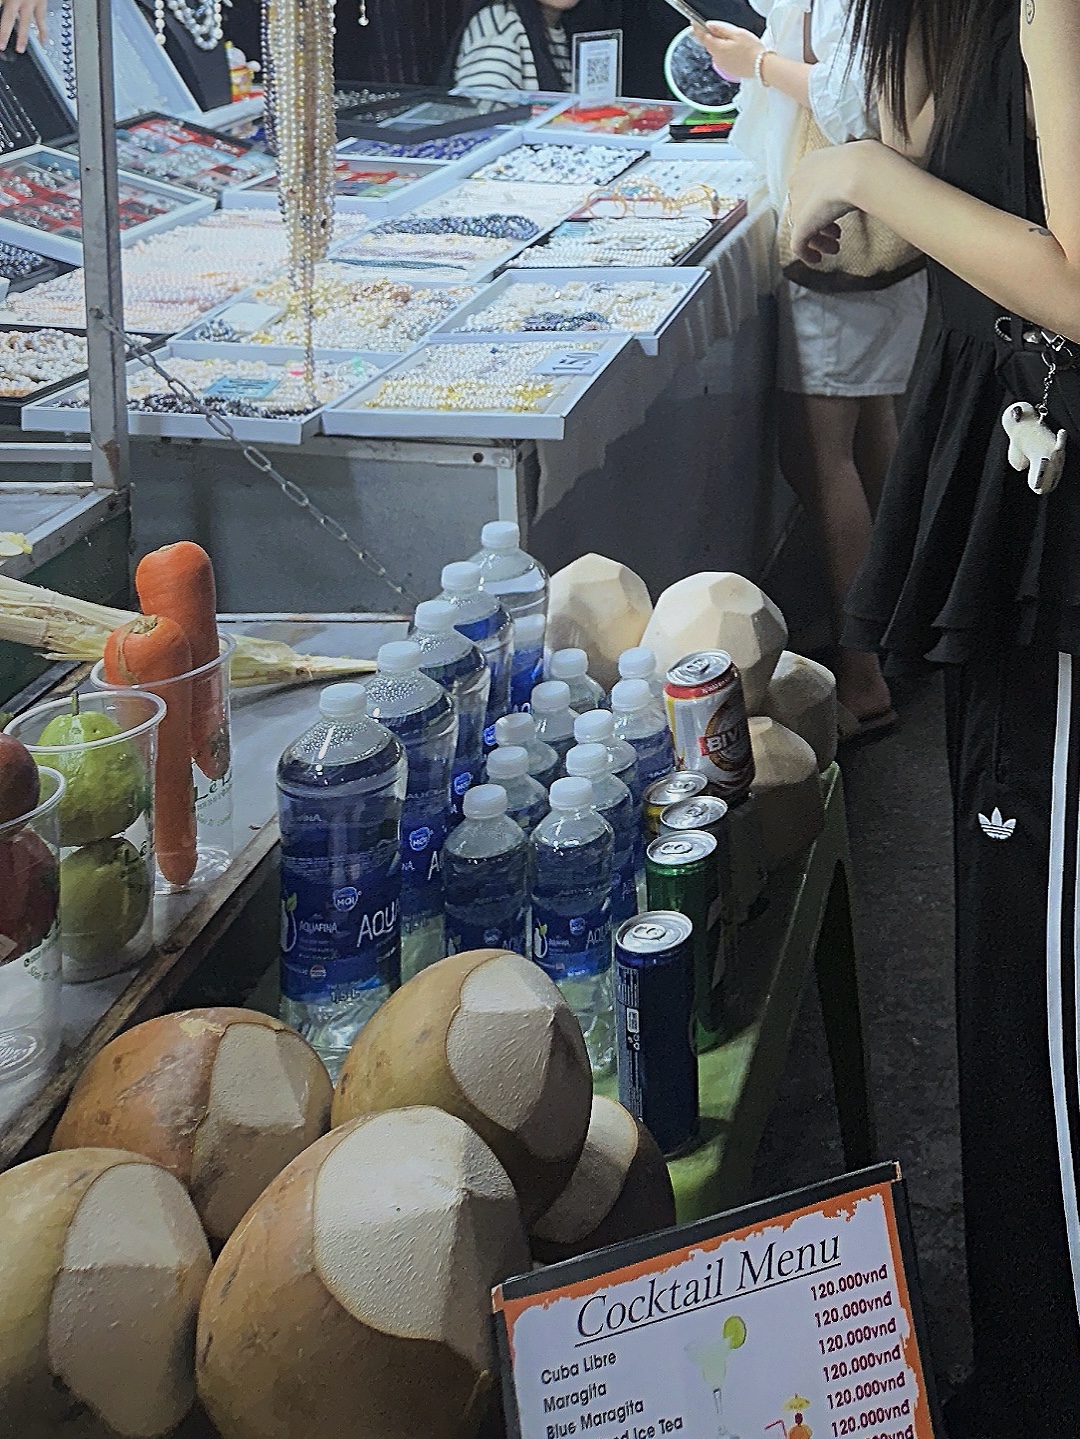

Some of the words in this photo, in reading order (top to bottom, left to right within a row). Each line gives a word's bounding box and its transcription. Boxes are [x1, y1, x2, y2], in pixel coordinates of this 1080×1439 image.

[577, 1257, 724, 1338] Cocktail
[736, 1234, 841, 1292] Menu
[541, 1361, 580, 1385] Cuba
[583, 1351, 617, 1372] Libre
[543, 1382, 607, 1414] Maragita
[546, 1420, 577, 1439] Blue
[580, 1399, 645, 1431] Maragita
[634, 1425, 656, 1439] Ice
[658, 1416, 684, 1436] Tea
